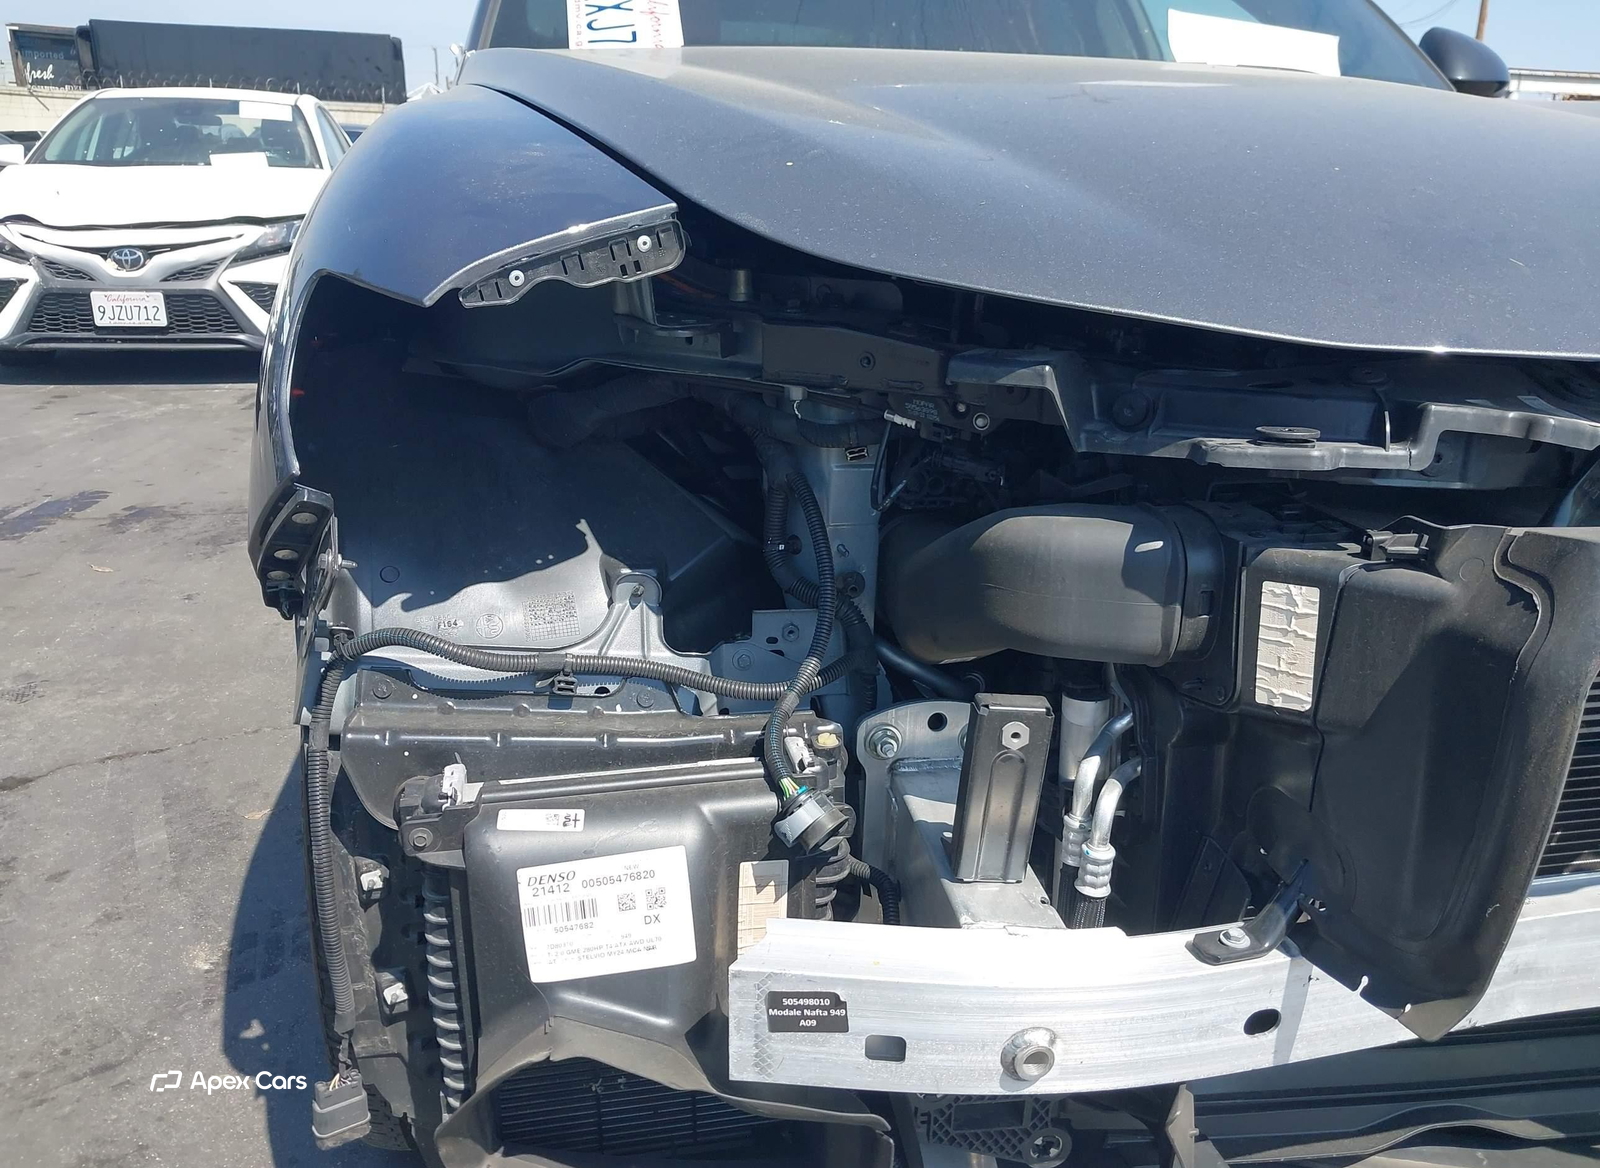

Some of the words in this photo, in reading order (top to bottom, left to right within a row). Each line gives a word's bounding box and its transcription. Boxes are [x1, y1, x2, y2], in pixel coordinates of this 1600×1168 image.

[106, 294, 149, 304] California
[97, 305, 161, 321] 9JZU712
[527, 870, 576, 887] DENSO
[532, 883, 570, 897] 21412
[581, 869, 656, 888] 00505476820
[644, 914, 661, 925] DX
[554, 922, 594, 933] 50547682
[782, 998, 831, 1006] 505498010
[768, 1008, 802, 1016] Modale
[803, 1008, 828, 1016] Nafta
[799, 1019, 817, 1027] A09
